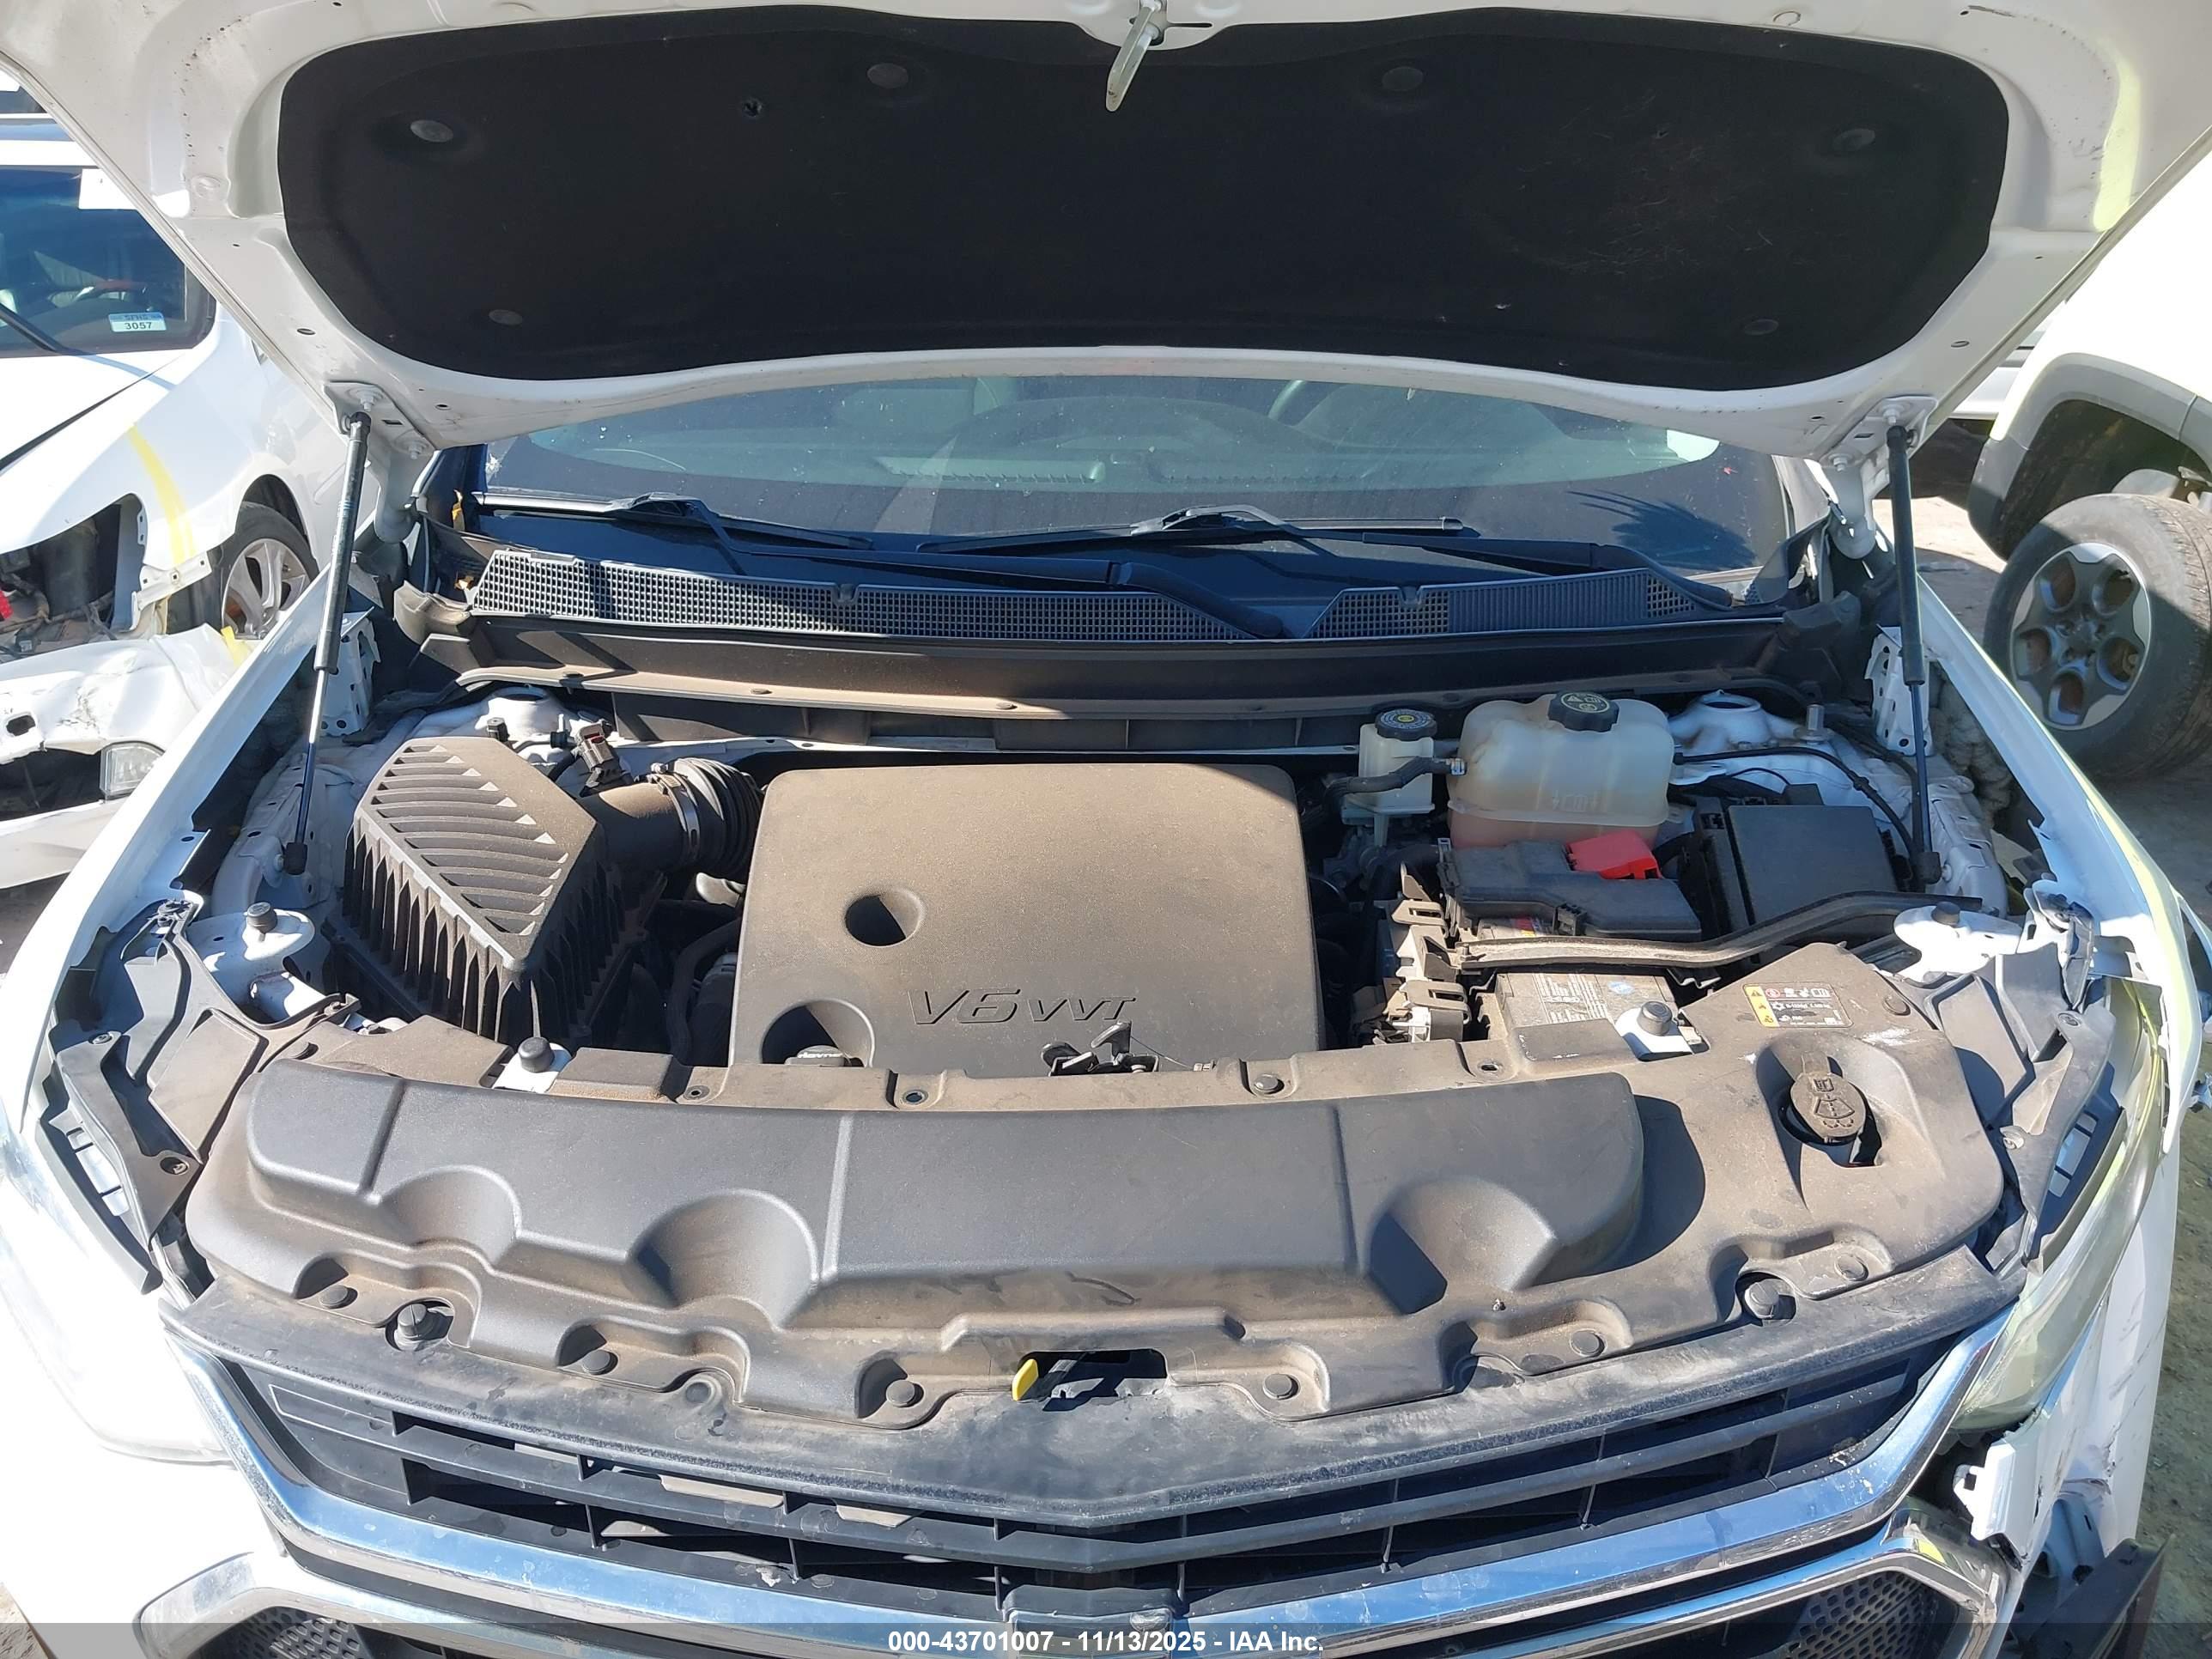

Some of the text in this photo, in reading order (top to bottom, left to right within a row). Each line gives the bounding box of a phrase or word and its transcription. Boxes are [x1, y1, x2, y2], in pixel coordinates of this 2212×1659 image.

[124, 321, 152, 330] 3057
[906, 988, 1136, 1025] V6 VVT
